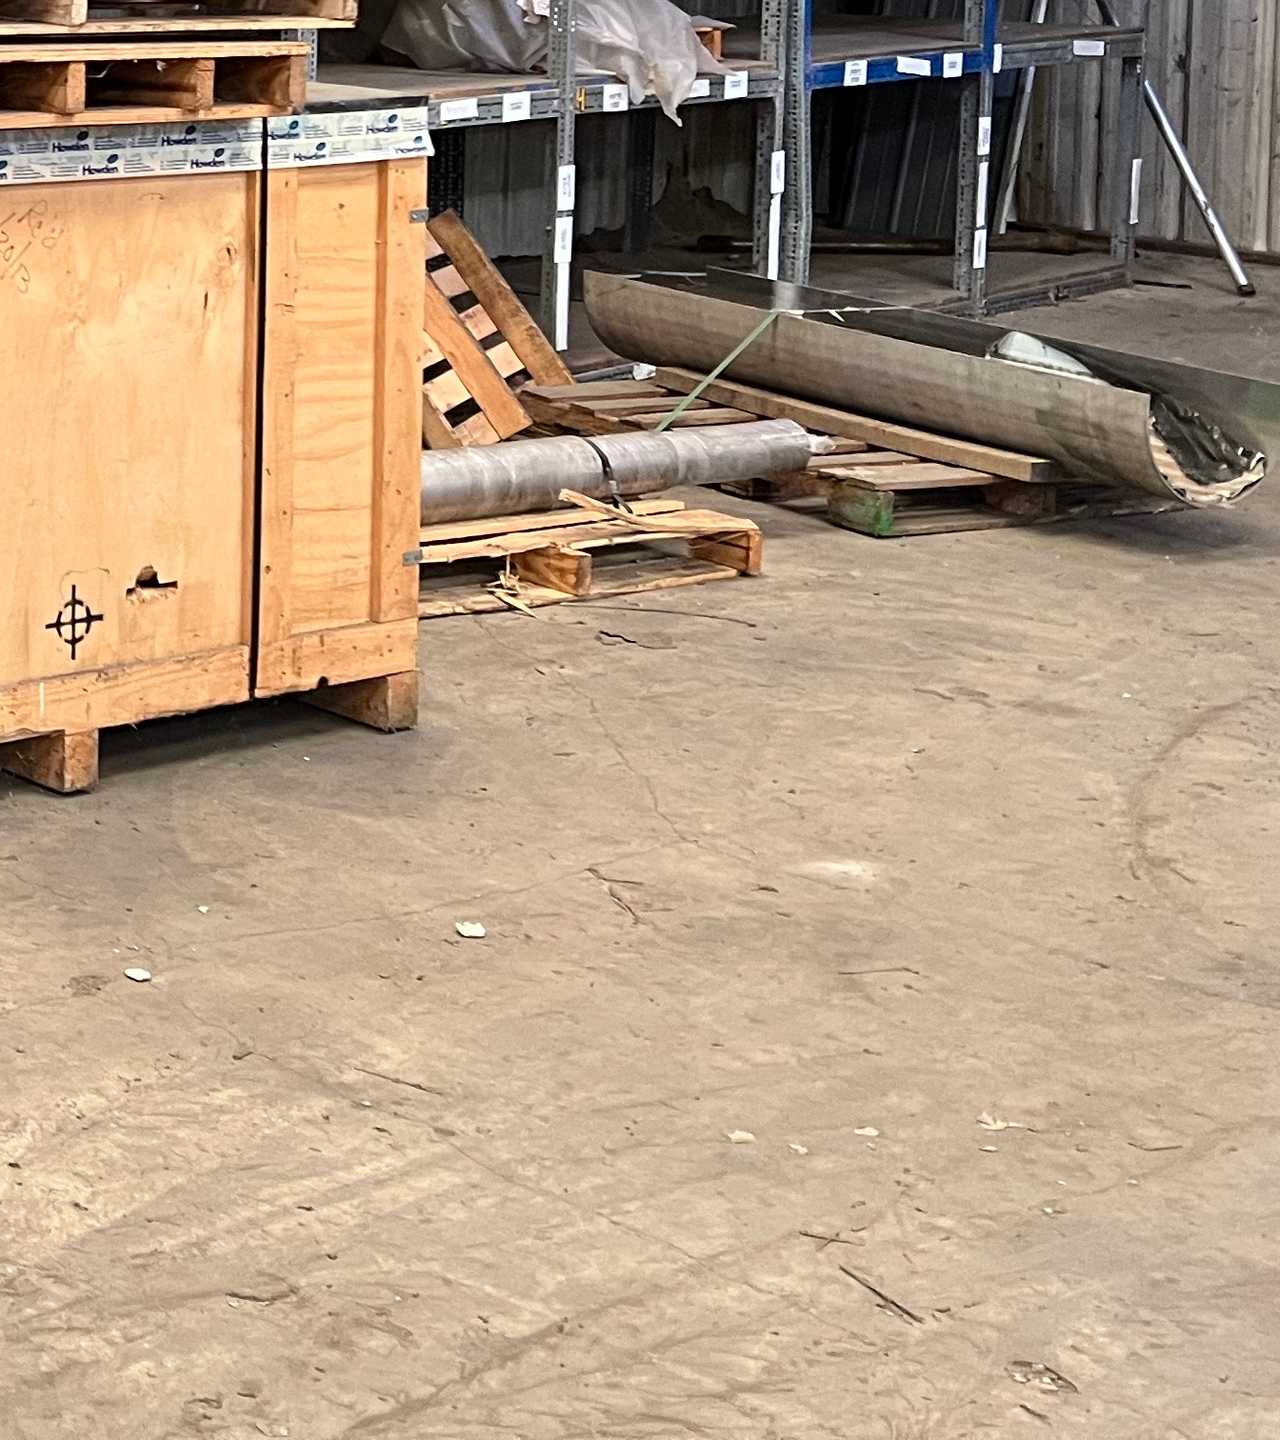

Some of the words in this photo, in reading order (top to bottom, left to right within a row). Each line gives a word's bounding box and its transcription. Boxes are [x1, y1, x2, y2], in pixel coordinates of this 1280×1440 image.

[52, 139, 90, 153] Howden
[161, 133, 198, 147] Howden
[190, 156, 226, 169] Howden
[82, 163, 119, 176] Howden
